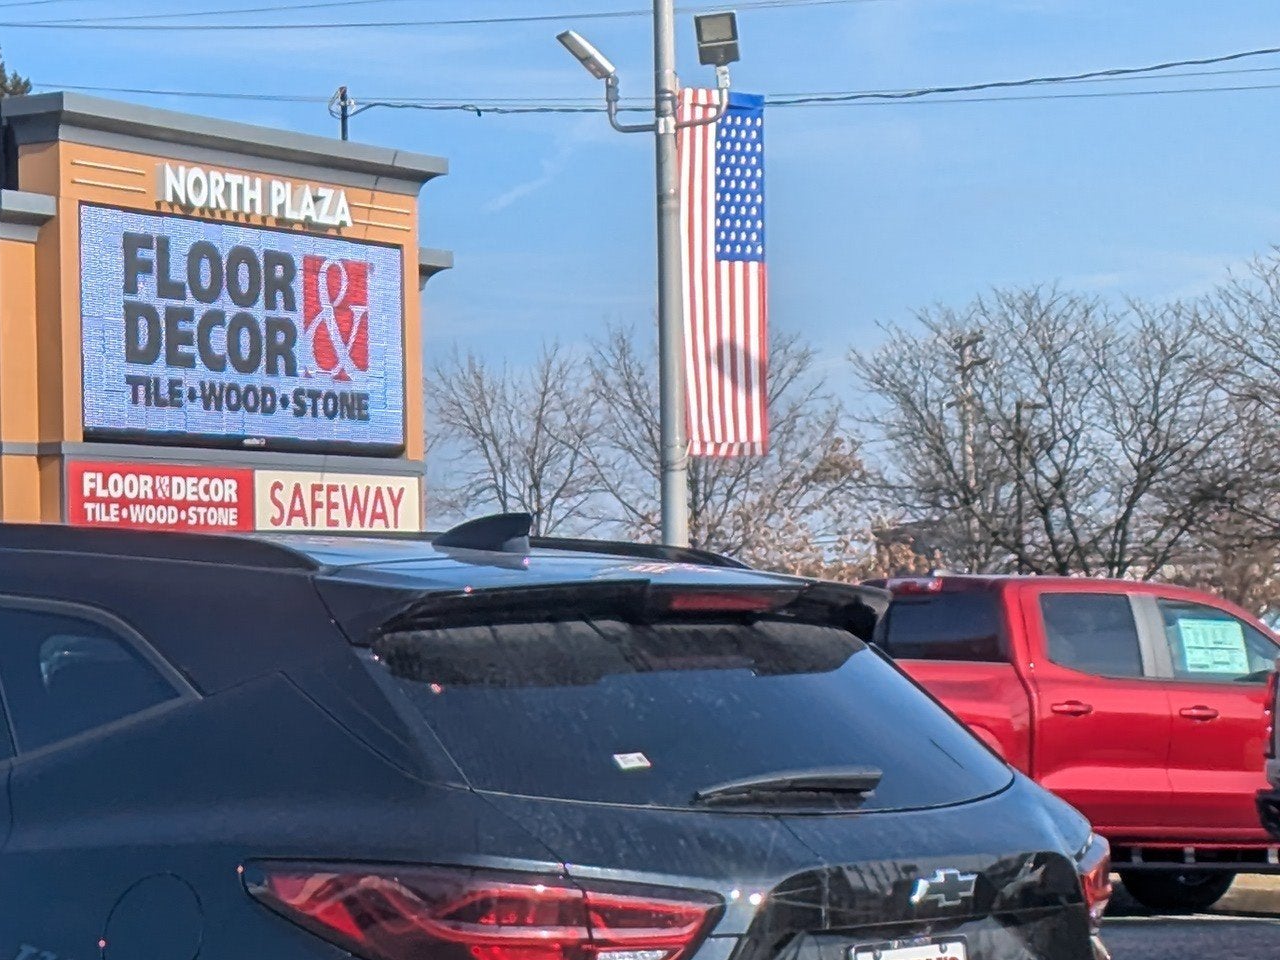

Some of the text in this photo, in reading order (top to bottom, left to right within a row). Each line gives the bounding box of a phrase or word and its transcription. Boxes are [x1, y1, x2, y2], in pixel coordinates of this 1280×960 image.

[164, 162, 354, 227] NORTH PLAZA
[122, 231, 297, 312] FLOOR
[123, 300, 299, 377] DECOR
[125, 375, 370, 421] TILE WOOD STONE
[83, 472, 154, 499] FLOOR
[172, 477, 238, 503] DECOR
[270, 480, 405, 529] SAFEWAY
[84, 503, 238, 526] TILE WOOD STONE
